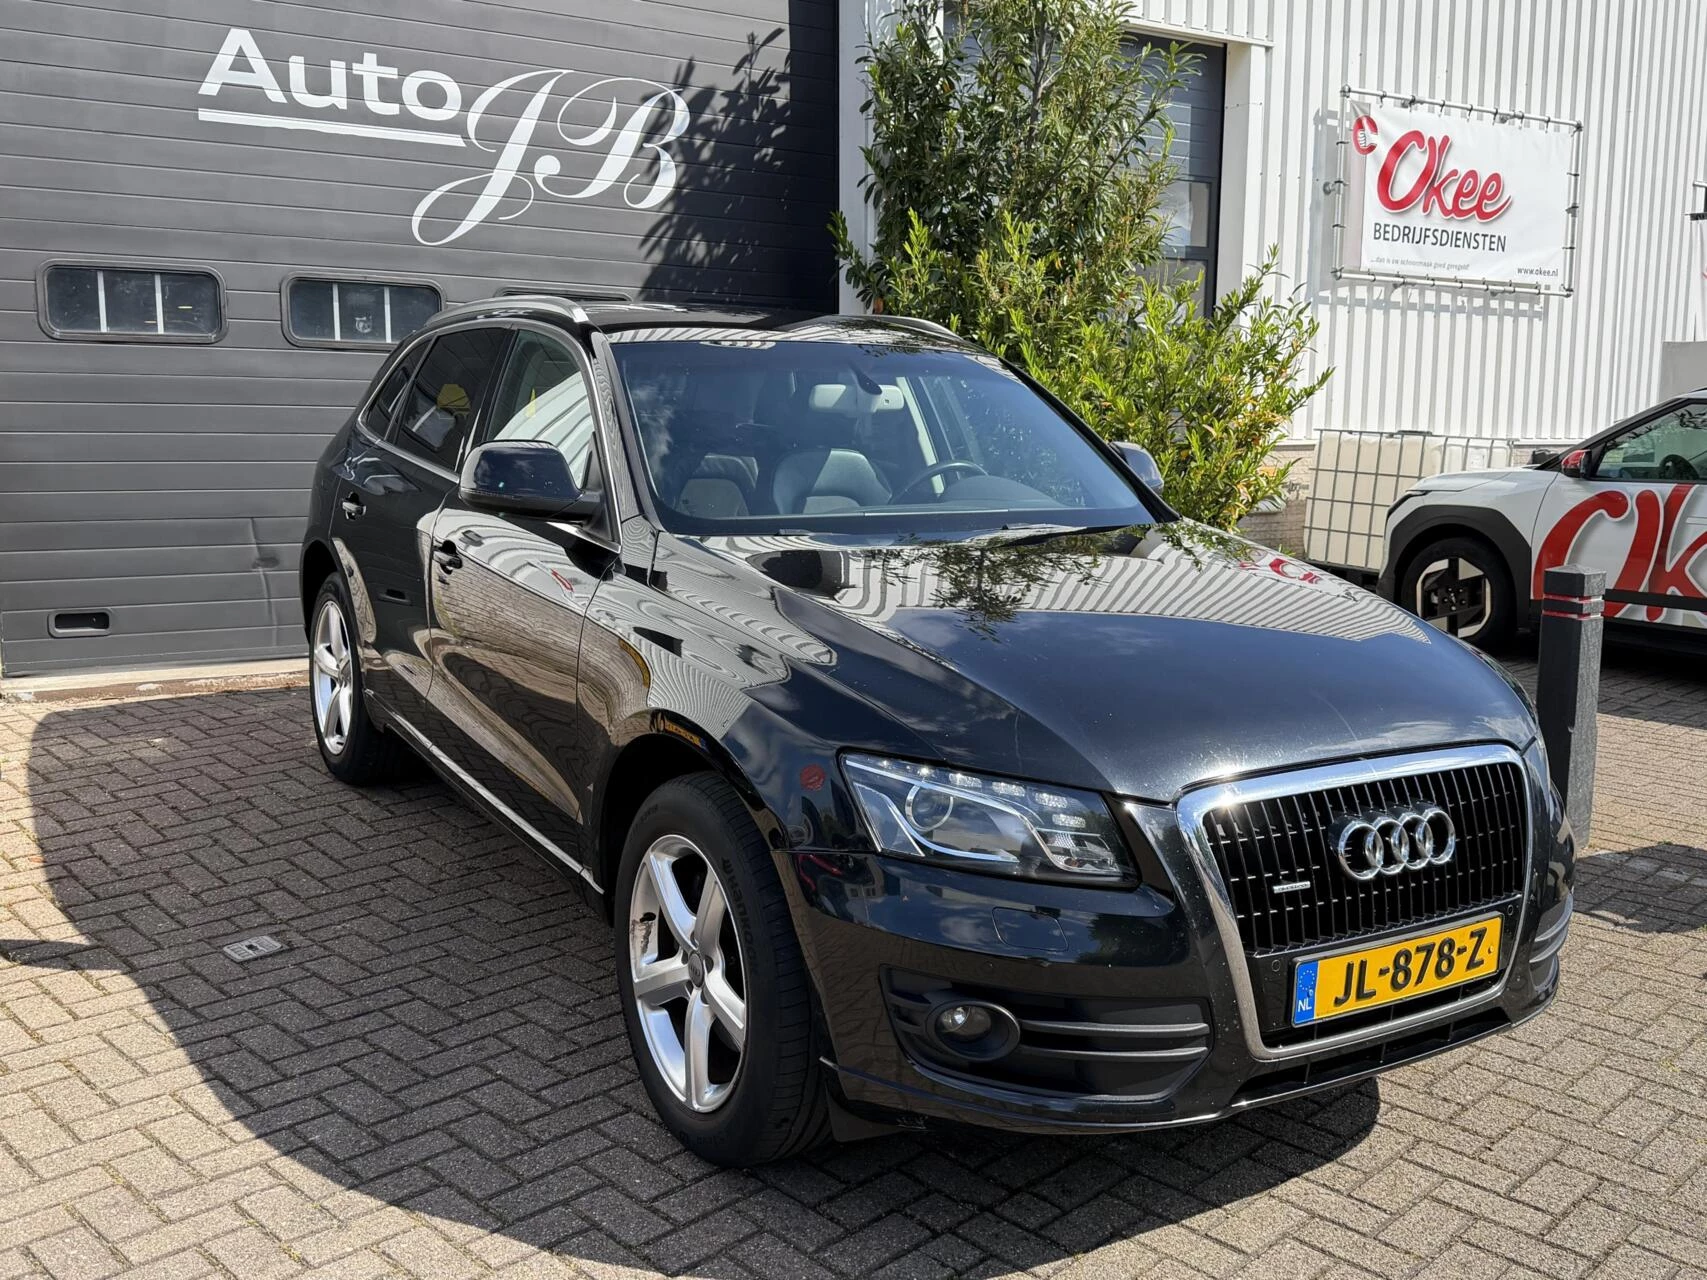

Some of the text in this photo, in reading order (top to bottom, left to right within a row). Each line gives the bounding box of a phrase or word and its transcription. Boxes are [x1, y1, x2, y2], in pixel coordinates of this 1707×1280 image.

[198, 28, 690, 246] Auto JB
[1377, 129, 1512, 221] Okee
[1373, 222, 1506, 252] BEDRIJFSDIENSTEN
[1297, 997, 1313, 1013] NL
[1334, 927, 1487, 1006] JL-878-Z
